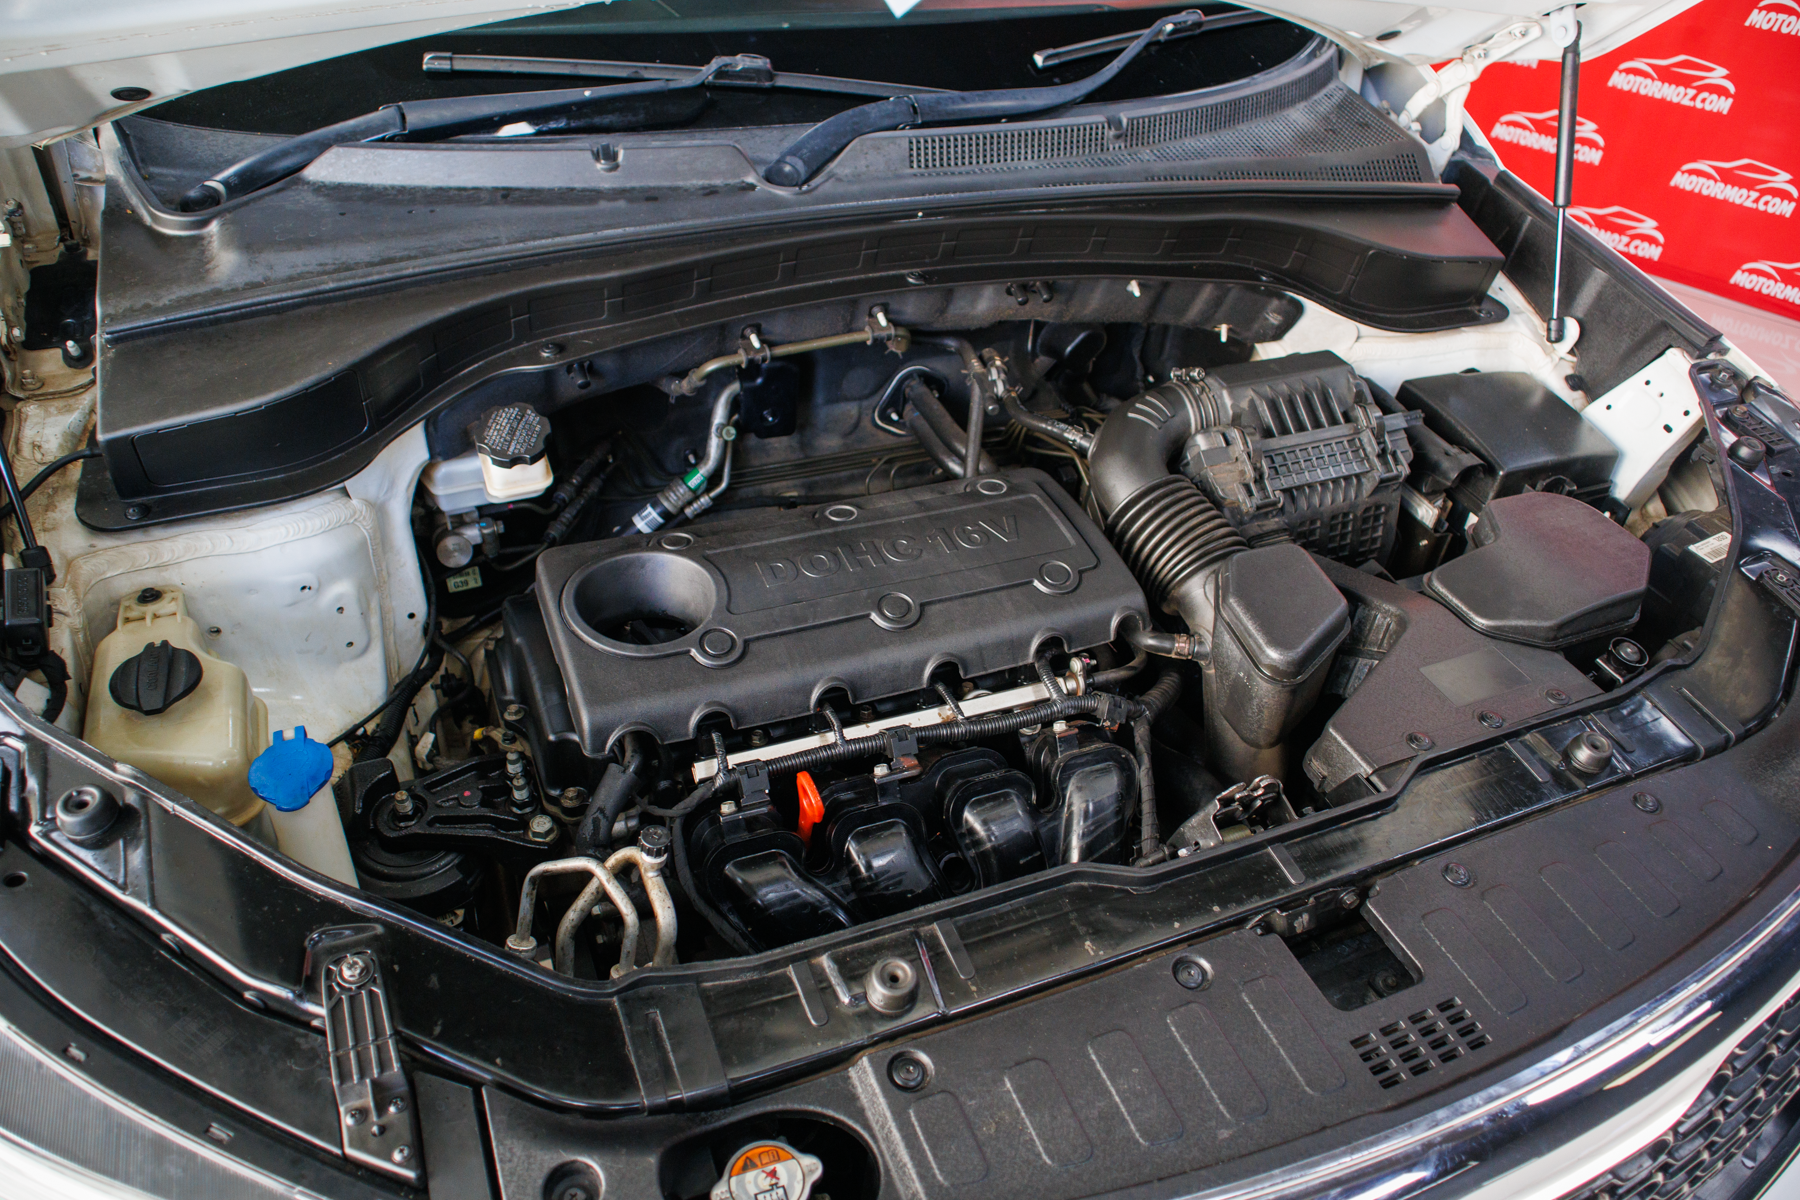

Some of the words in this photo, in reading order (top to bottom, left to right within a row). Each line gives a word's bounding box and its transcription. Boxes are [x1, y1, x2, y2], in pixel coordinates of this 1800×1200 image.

[1607, 70, 1734, 115] MOTORMOZ.COM
[1669, 171, 1796, 218] MOTORMOZ.COM
[755, 533, 923, 588] DOHC
[926, 514, 1020, 554] 16V
